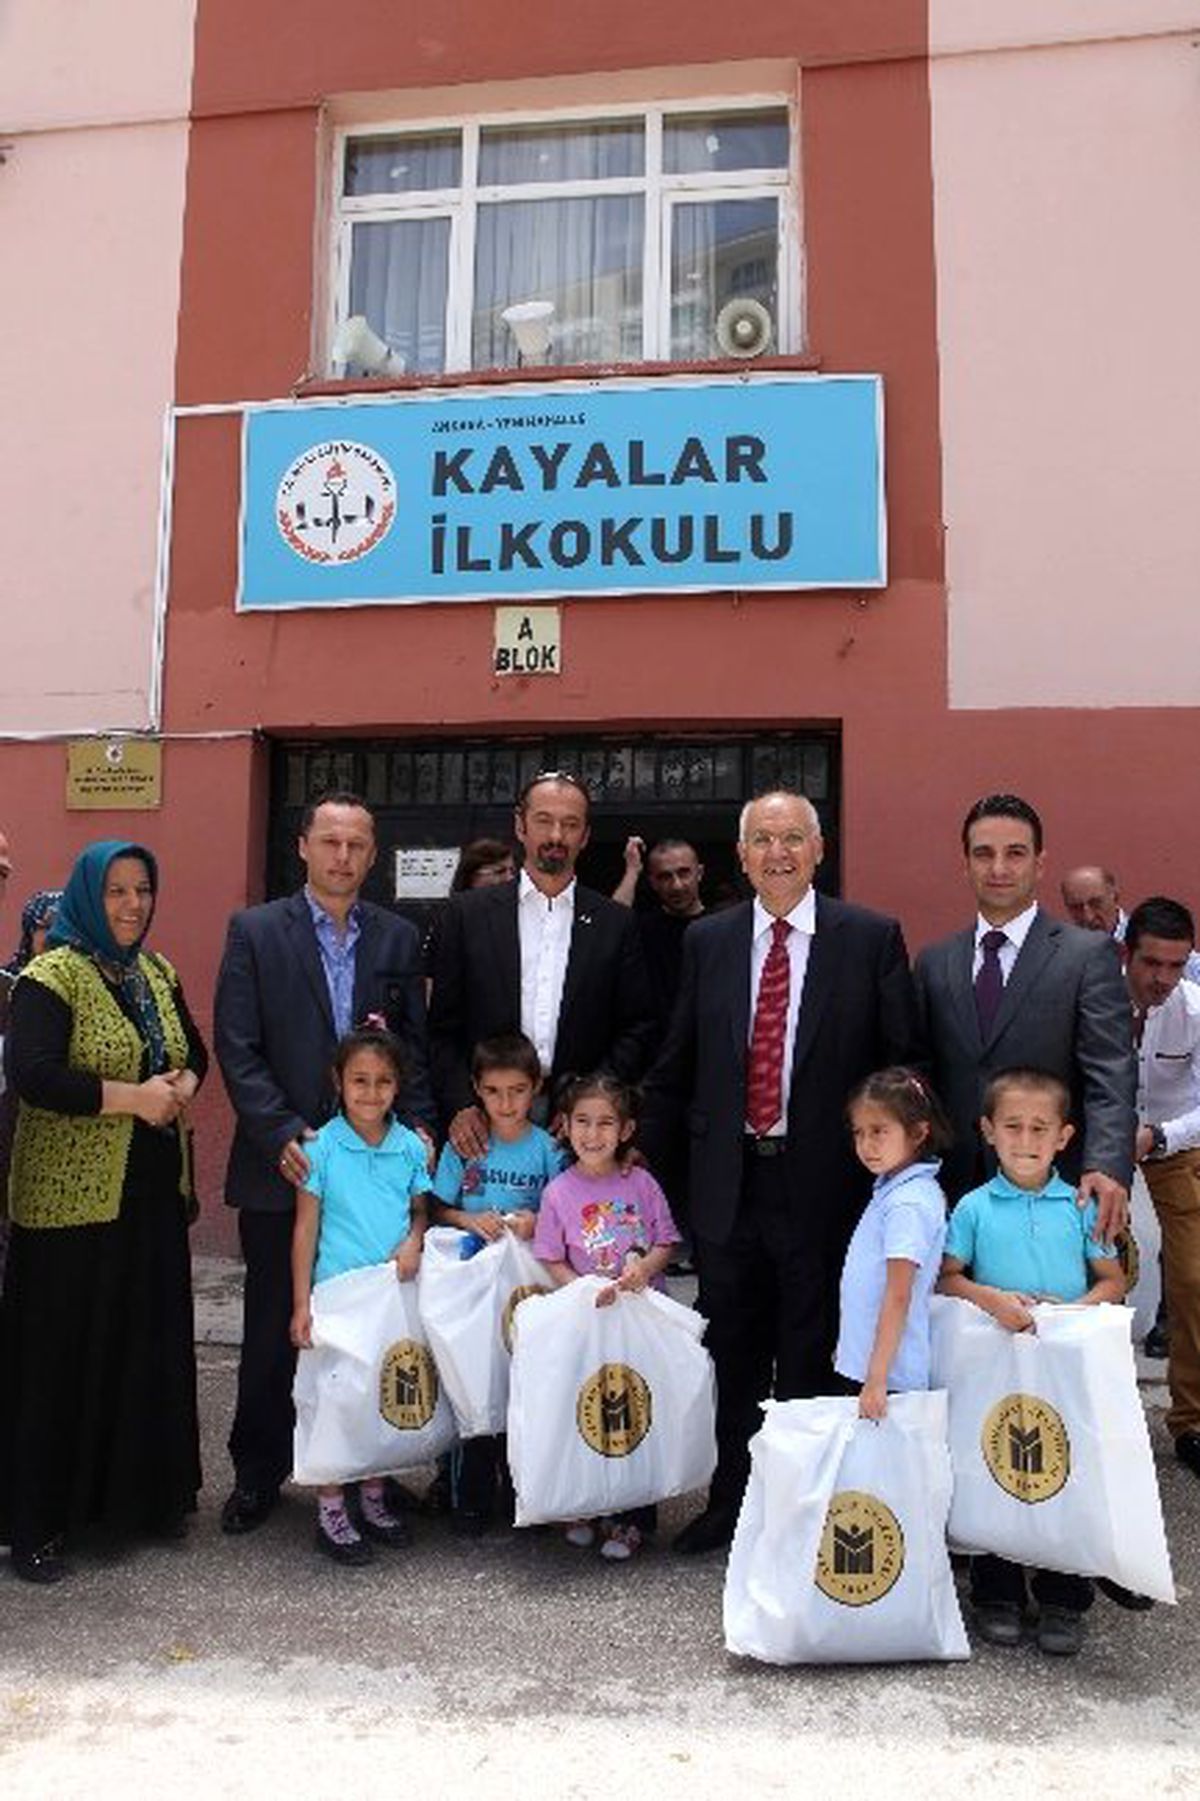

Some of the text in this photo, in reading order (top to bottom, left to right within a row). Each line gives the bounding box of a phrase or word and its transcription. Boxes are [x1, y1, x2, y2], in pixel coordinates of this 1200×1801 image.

[432, 435, 768, 496] KAYALAR
[431, 512, 793, 574] İLKOKULU
[518, 617, 533, 640] A
[496, 645, 556, 671] BLOK
